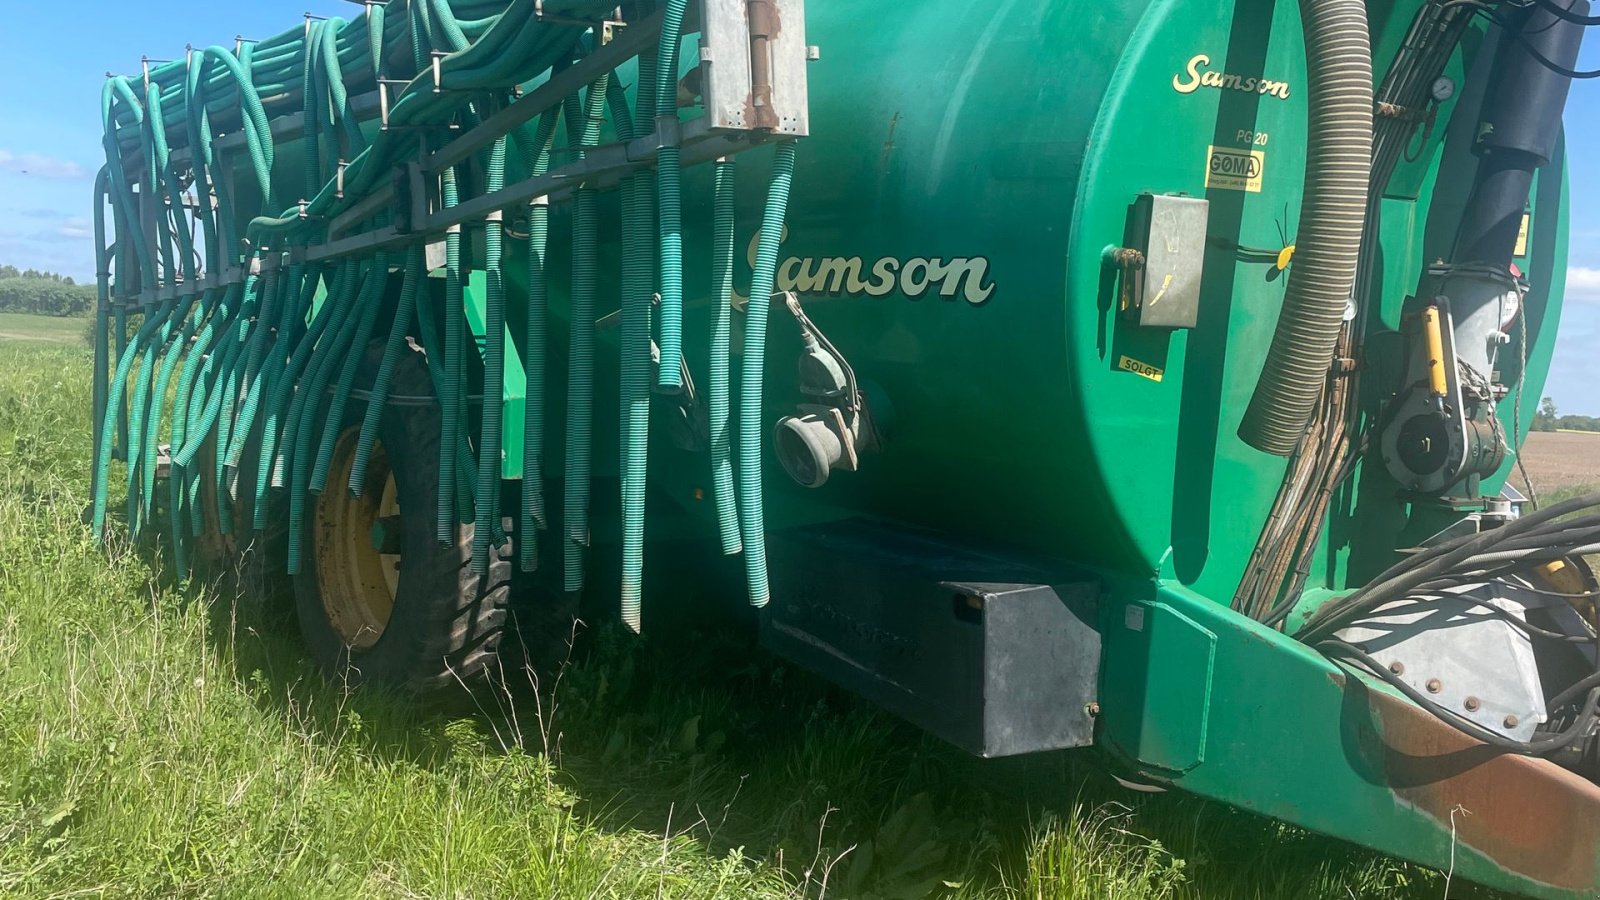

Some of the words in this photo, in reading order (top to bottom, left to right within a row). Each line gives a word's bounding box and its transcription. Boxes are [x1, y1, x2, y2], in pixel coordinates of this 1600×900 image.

[1173, 54, 1290, 99] Samson
[1236, 129, 1253, 143] PG
[1253, 132, 1268, 146] 20
[1210, 155, 1256, 175] GØMA
[1124, 359, 1159, 378] SOLGT
